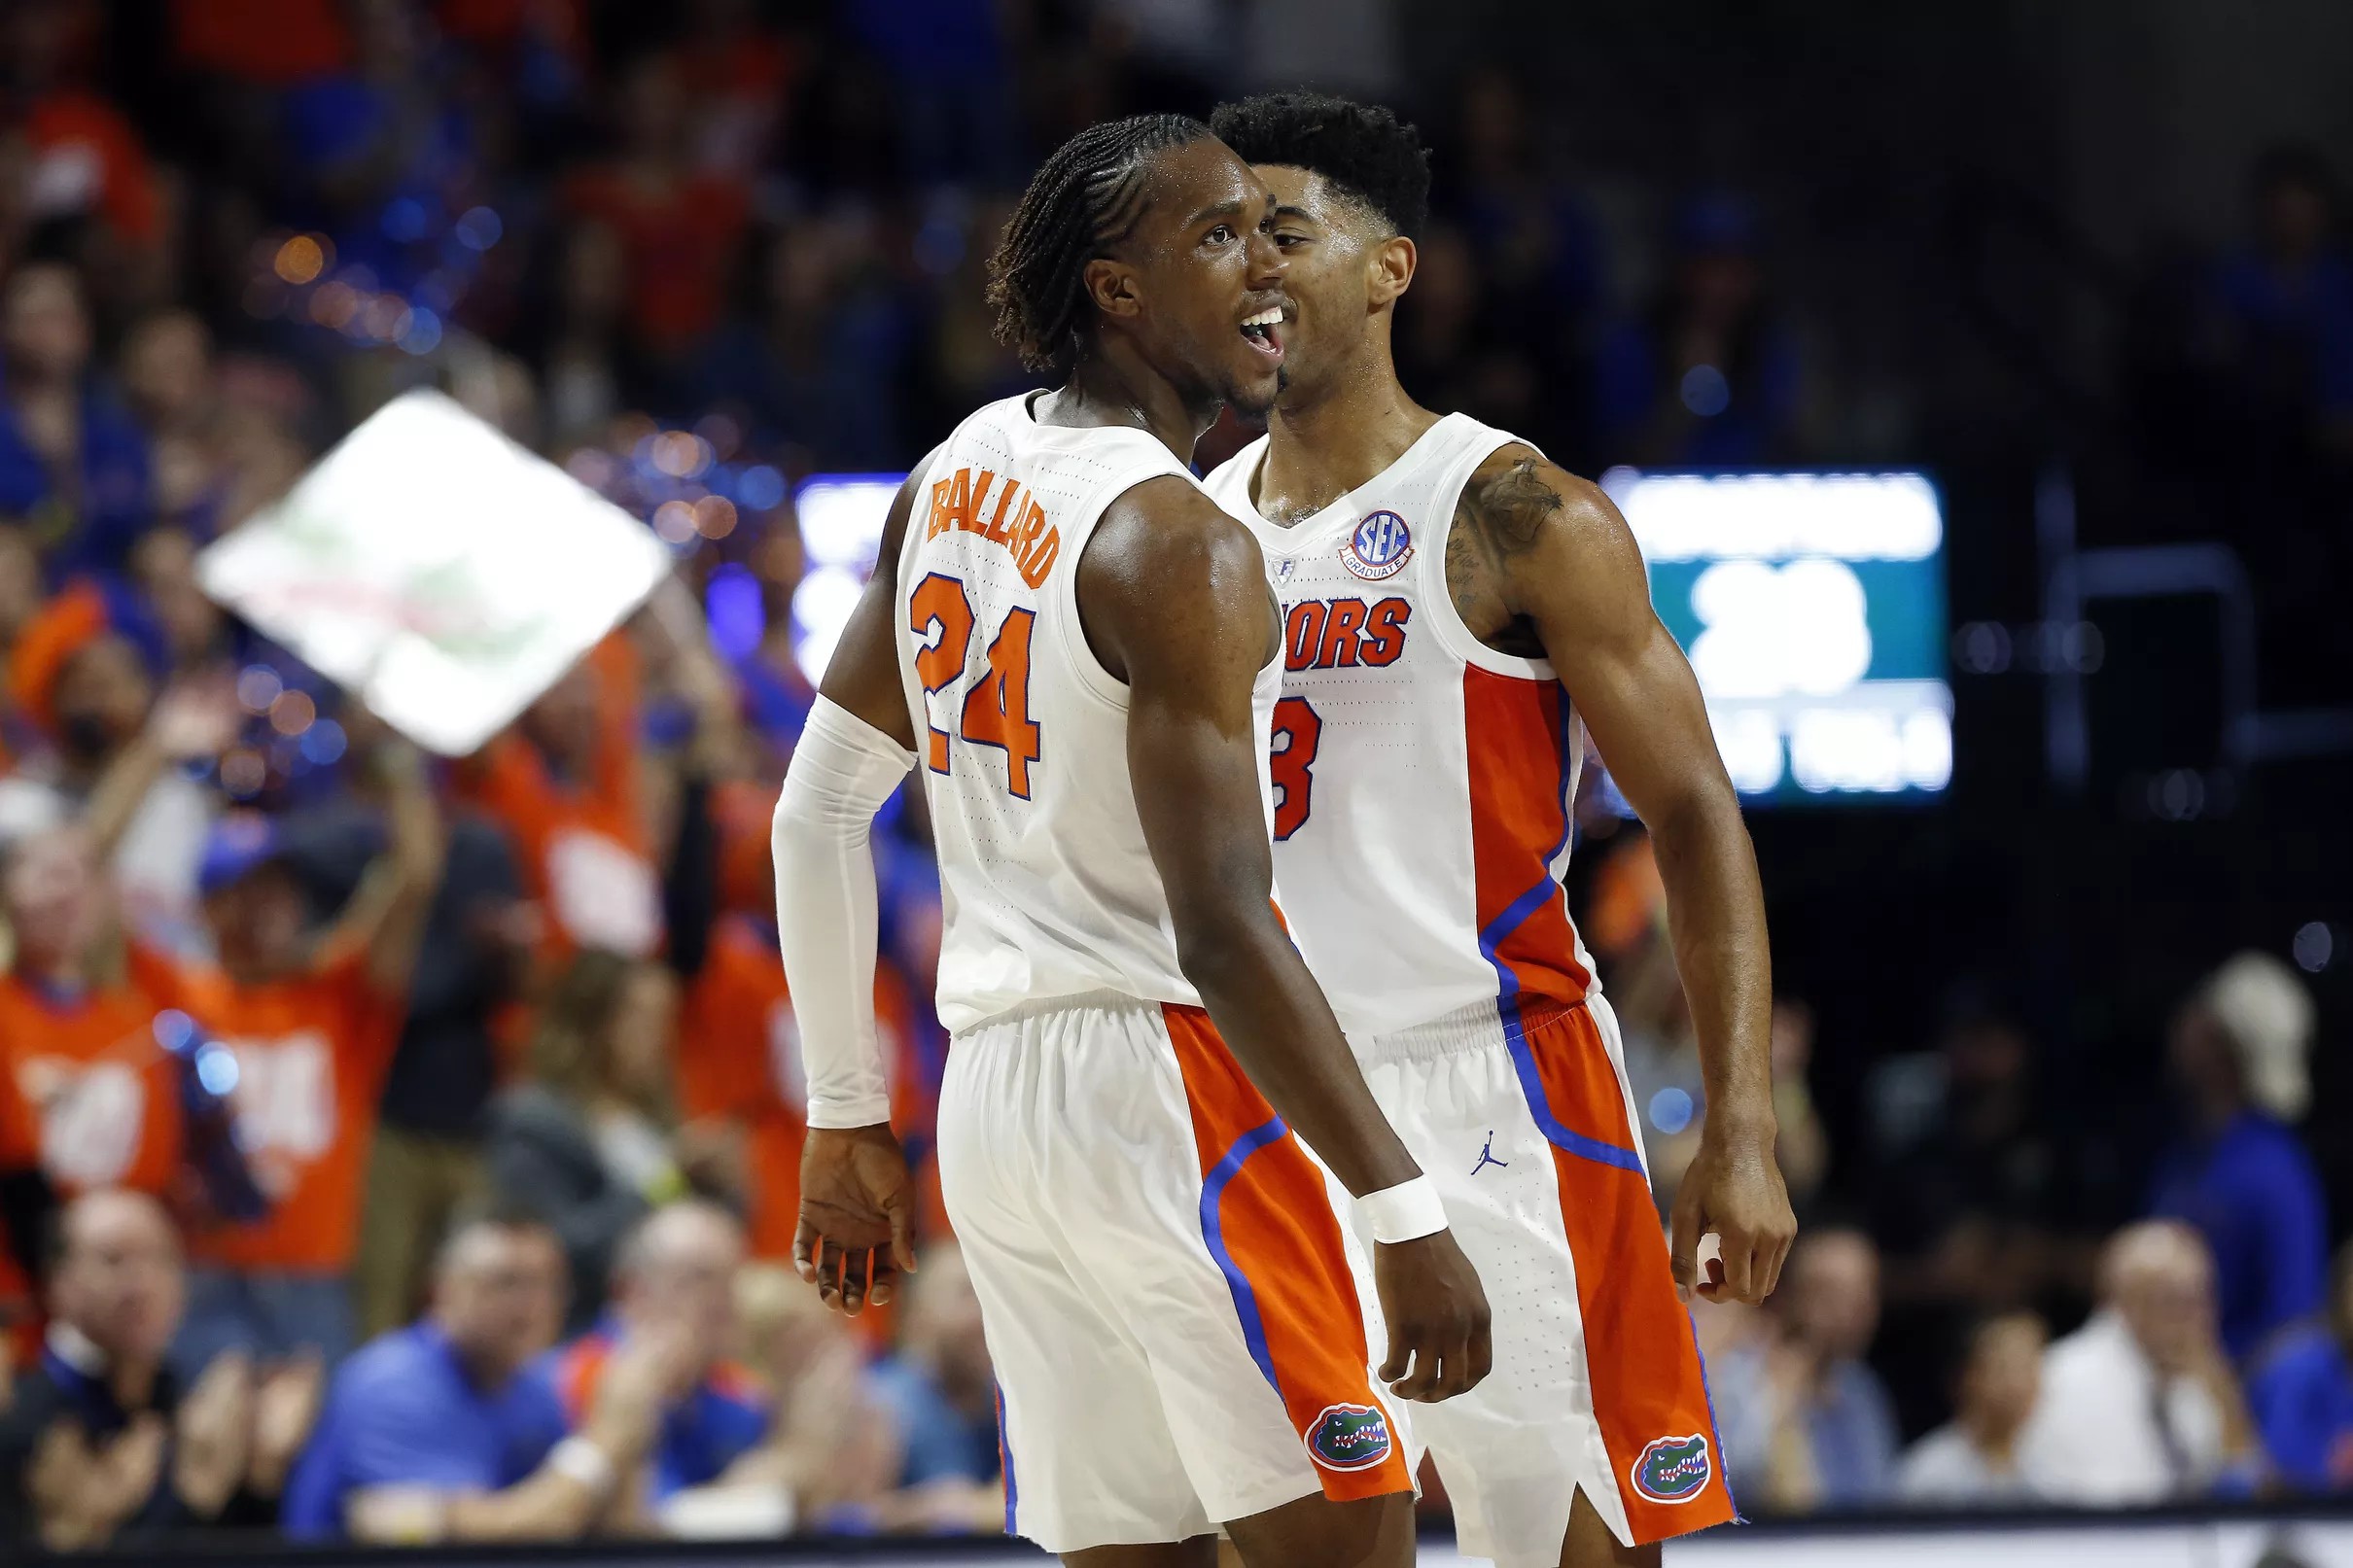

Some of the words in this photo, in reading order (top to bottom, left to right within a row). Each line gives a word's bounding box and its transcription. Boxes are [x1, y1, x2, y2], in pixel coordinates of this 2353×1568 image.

[927, 467, 1061, 590] BALLARD
[1345, 557, 1403, 577] GRADUATE
[1358, 514, 1405, 563] SEC
[1282, 597, 1413, 672] ORS
[910, 571, 1041, 802] 24
[1270, 695, 1322, 842] 3
